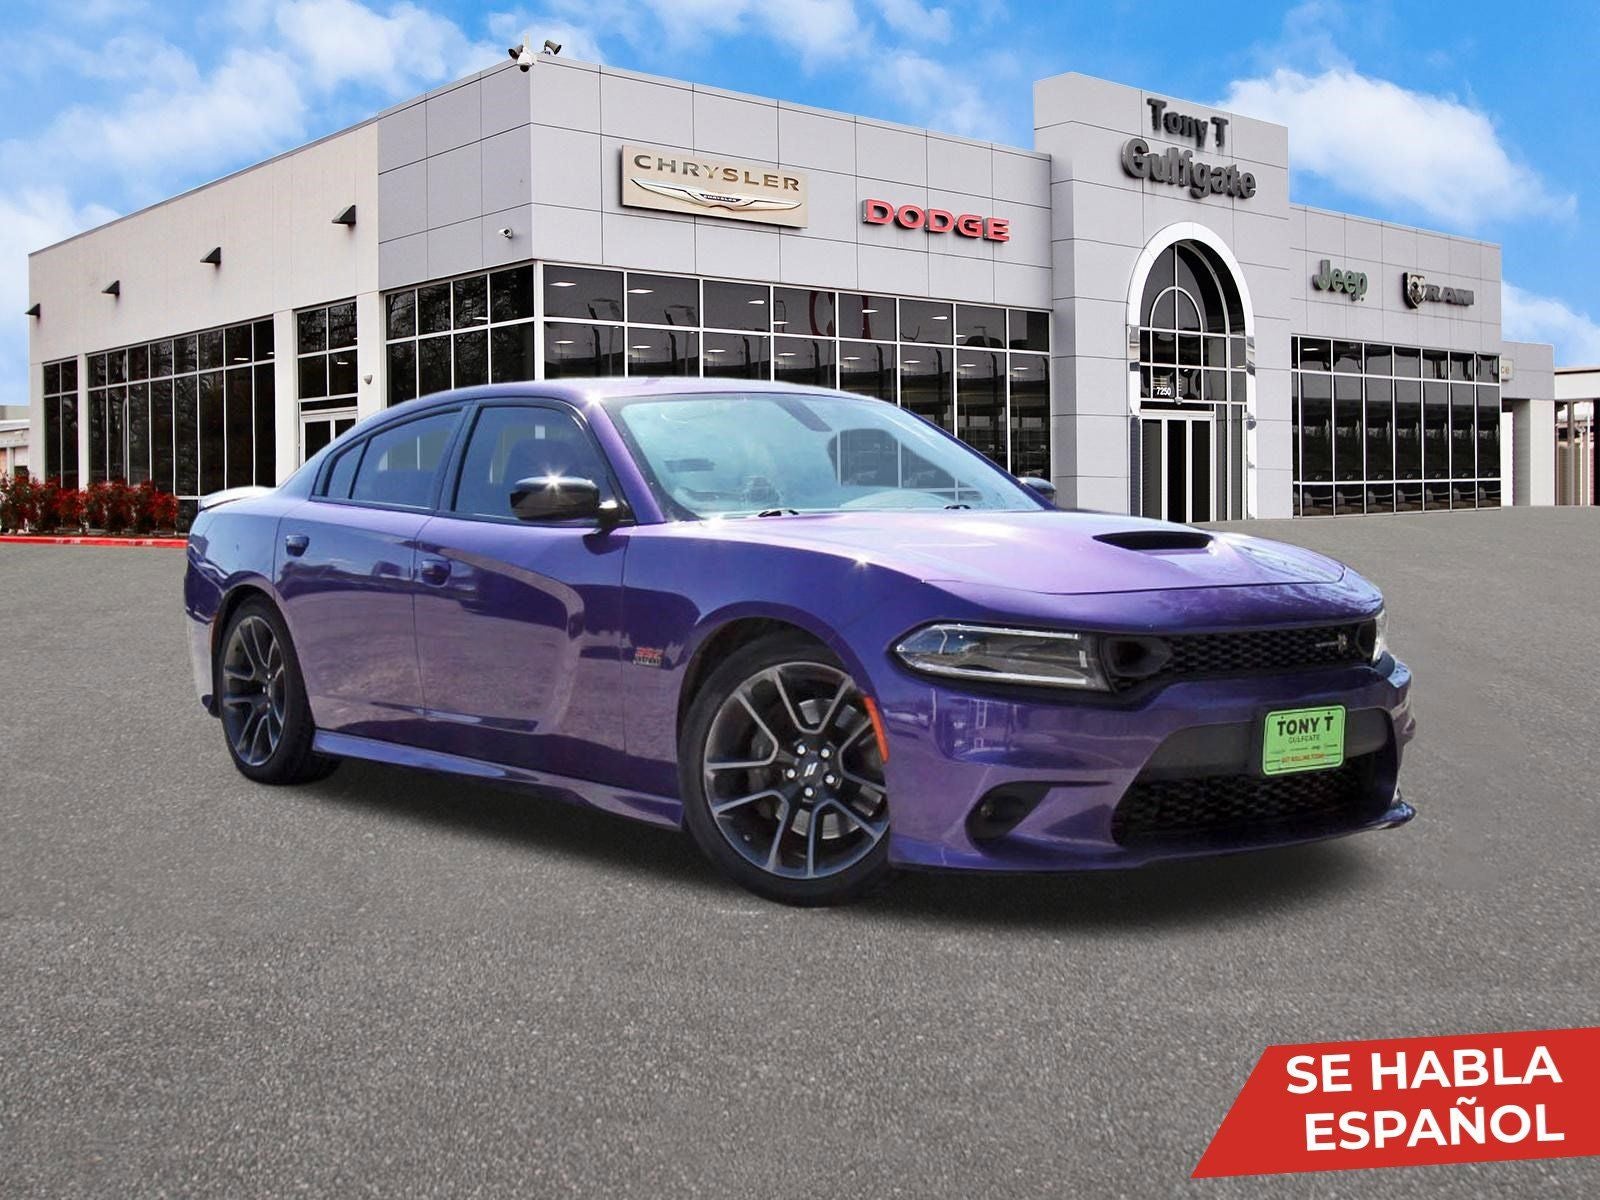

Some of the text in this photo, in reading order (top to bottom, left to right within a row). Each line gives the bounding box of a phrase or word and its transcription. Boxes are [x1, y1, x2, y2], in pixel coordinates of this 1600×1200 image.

[1146, 98, 1229, 148] Tony T
[634, 154, 800, 192] CHRYSLER
[1121, 138, 1257, 199] Gulfgate
[863, 199, 1010, 242] DODGE
[1313, 259, 1368, 301] Jeep
[1425, 284, 1474, 306] RAM
[1156, 387, 1172, 396] 7250
[1277, 716, 1334, 736] TONY T
